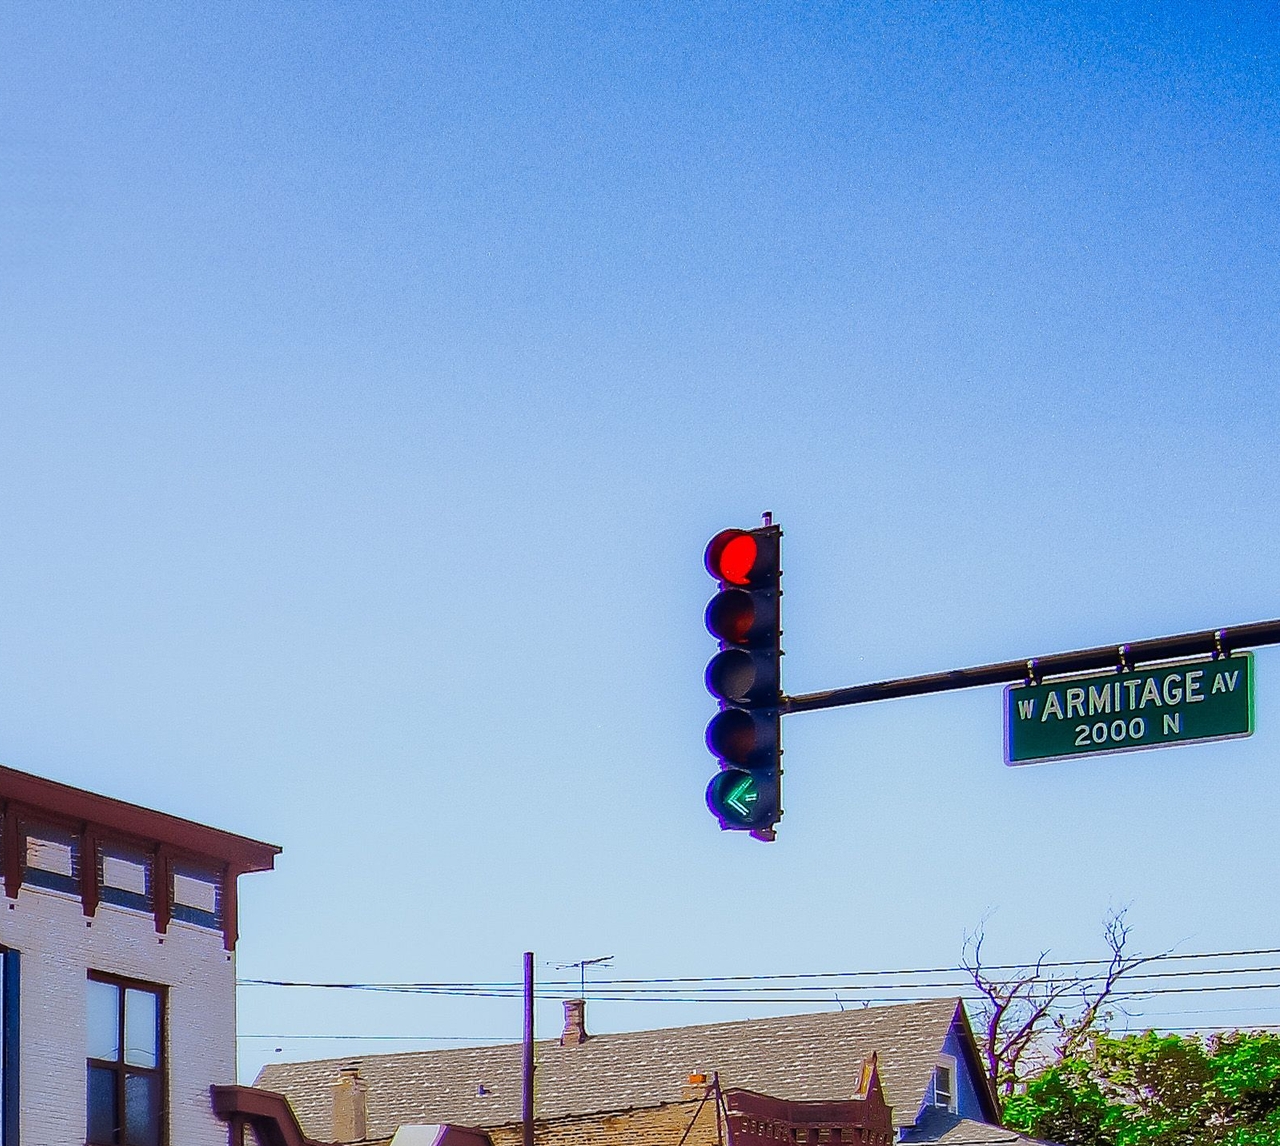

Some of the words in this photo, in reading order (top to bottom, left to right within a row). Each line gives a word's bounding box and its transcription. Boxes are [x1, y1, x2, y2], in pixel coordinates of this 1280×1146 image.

[1017, 699, 1034, 720] W
[1040, 671, 1205, 722] ARMITAGE
[1211, 671, 1239, 695] AV
[1074, 717, 1145, 746] 2000
[1163, 712, 1180, 735] N
